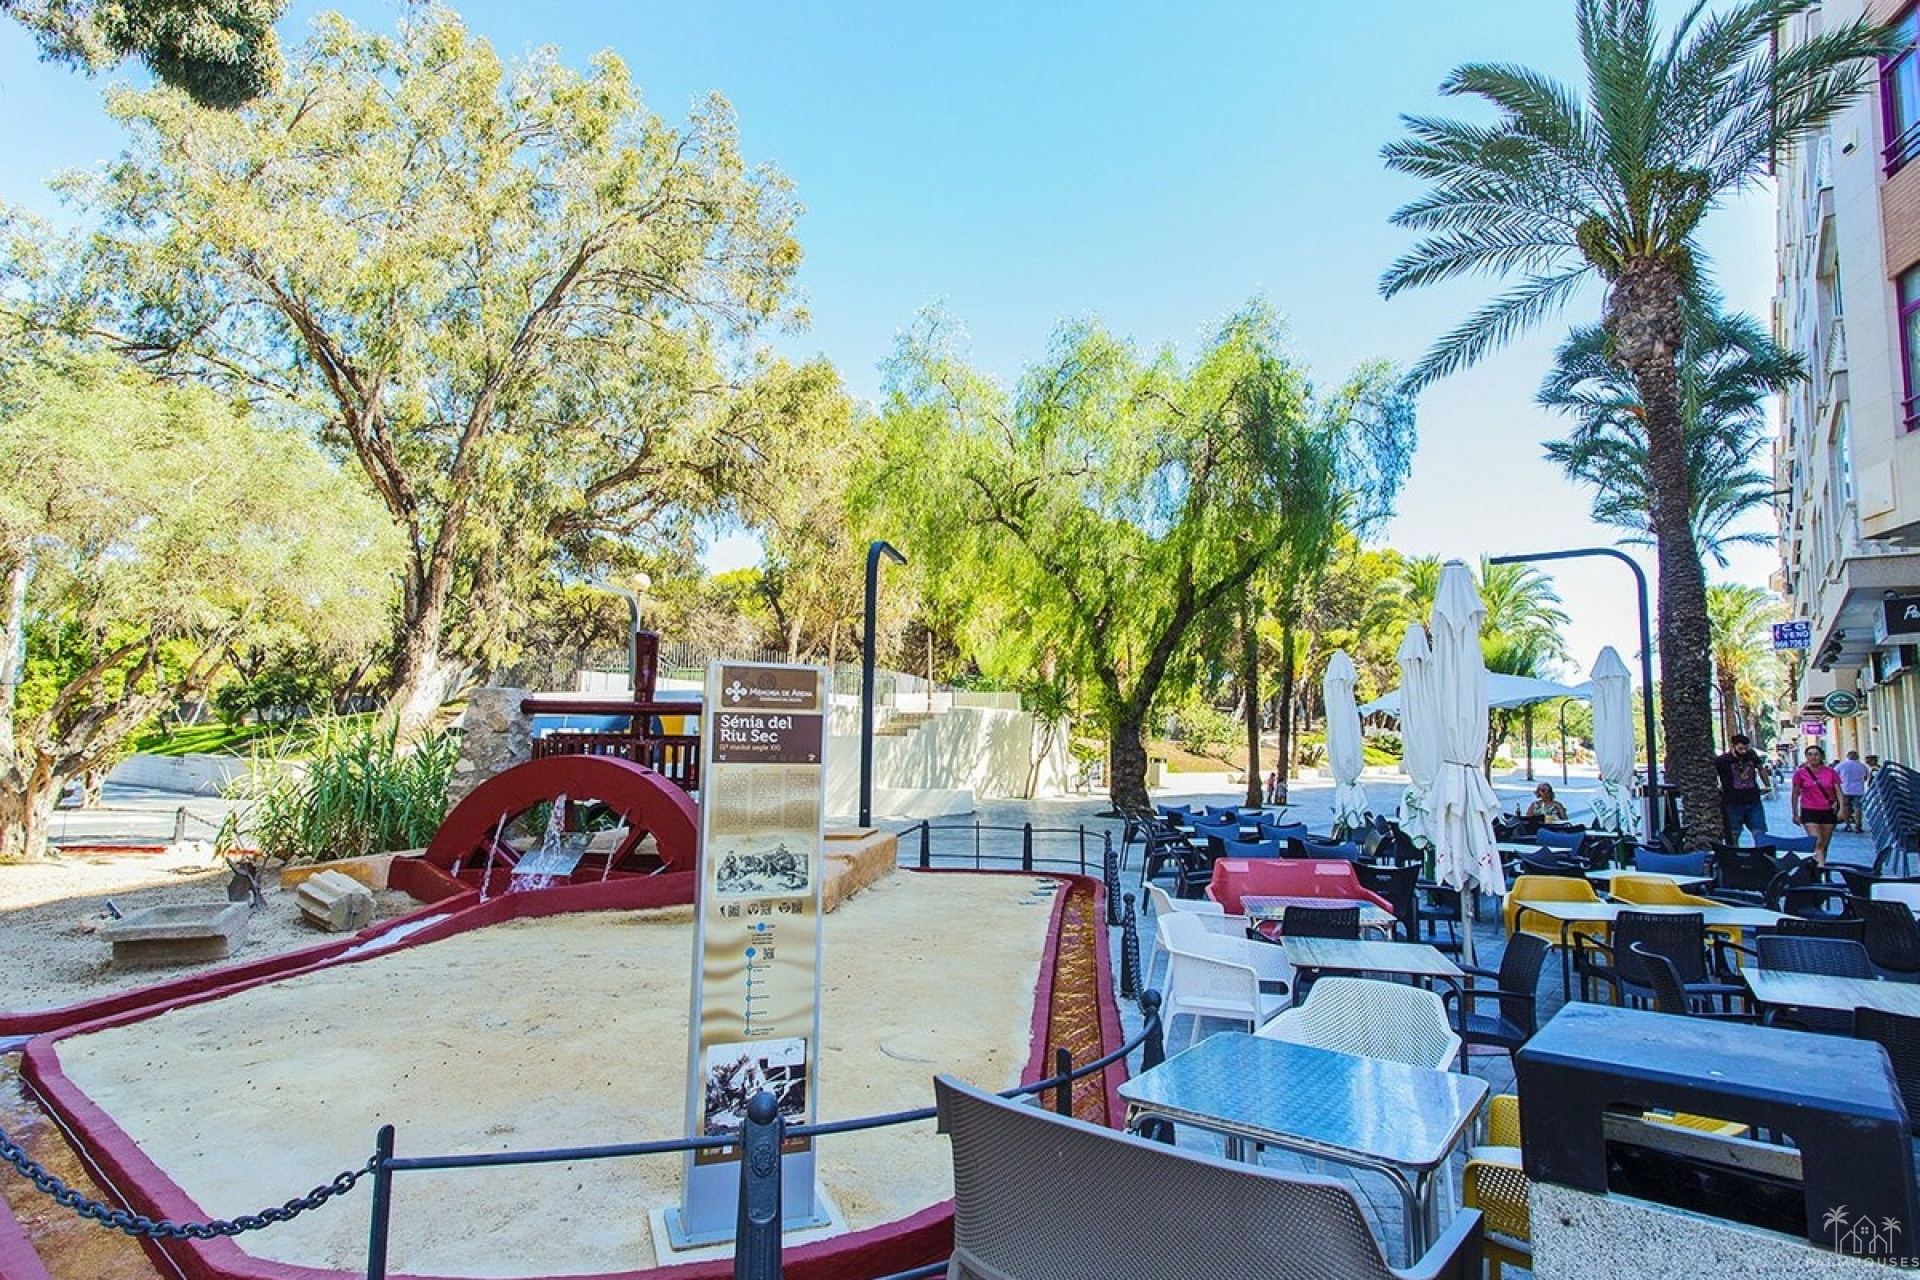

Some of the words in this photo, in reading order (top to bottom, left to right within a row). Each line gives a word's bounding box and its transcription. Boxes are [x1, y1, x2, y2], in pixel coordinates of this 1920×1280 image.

[721, 714, 764, 728] Sénia
[768, 716, 793, 729] del
[720, 729, 747, 742] Riu
[751, 729, 779, 743] Sec
